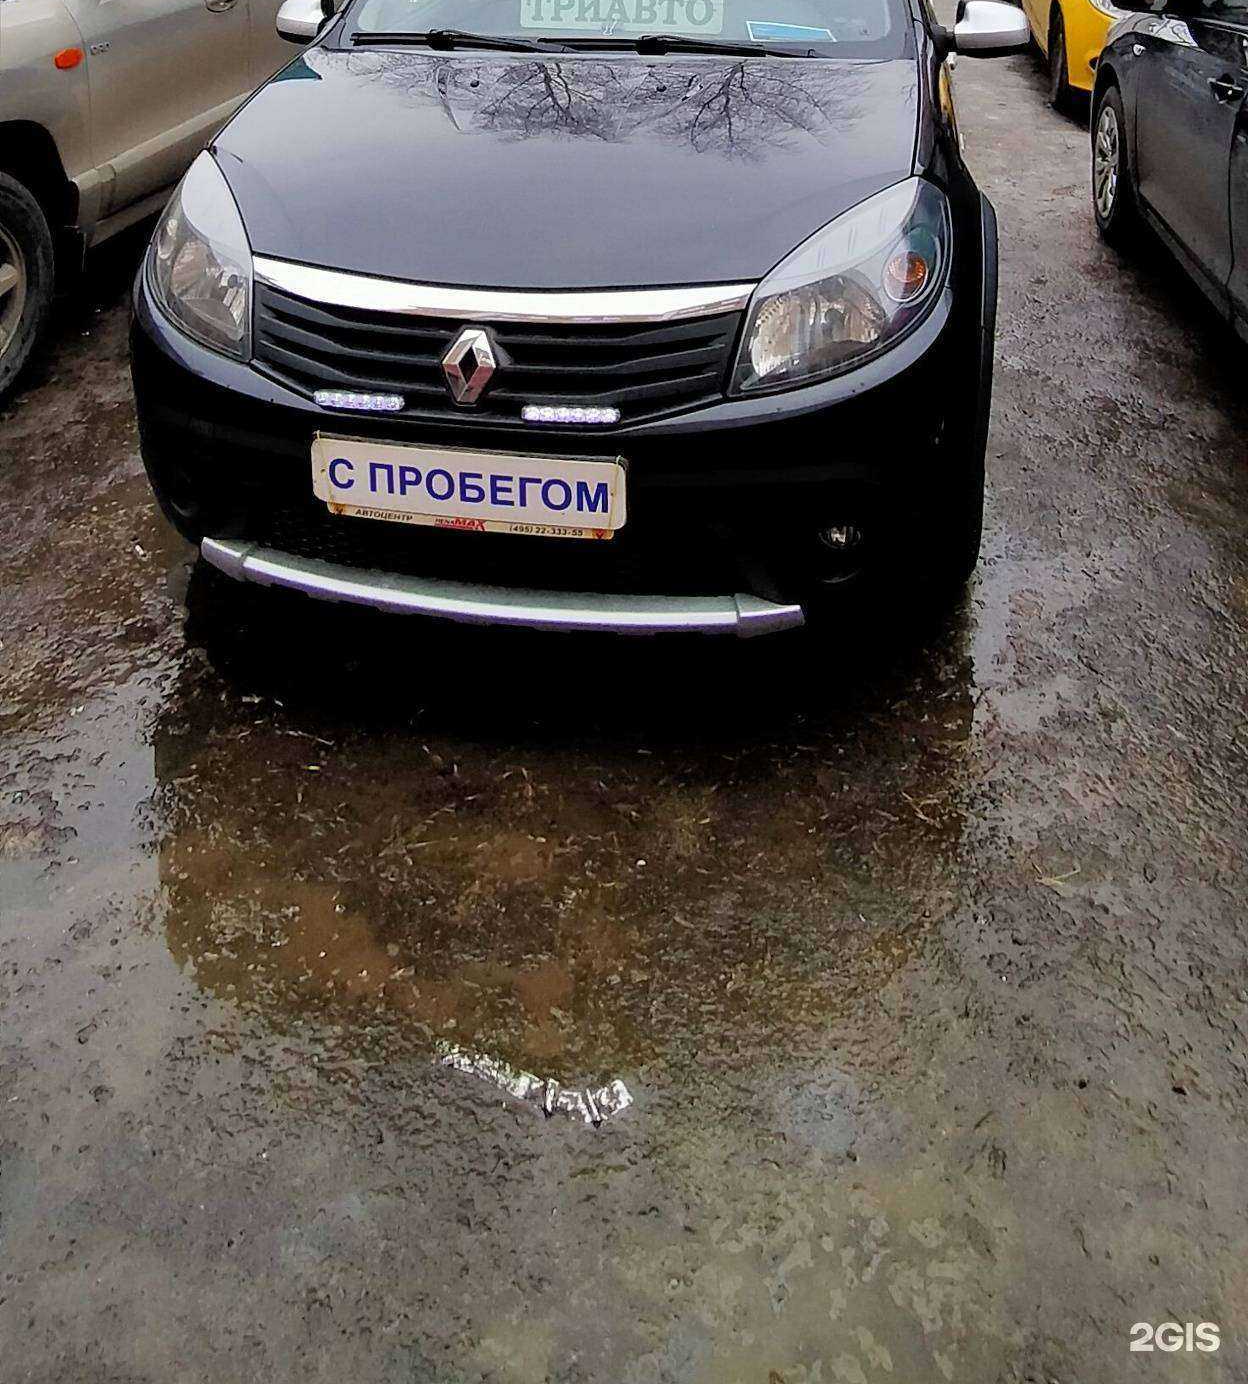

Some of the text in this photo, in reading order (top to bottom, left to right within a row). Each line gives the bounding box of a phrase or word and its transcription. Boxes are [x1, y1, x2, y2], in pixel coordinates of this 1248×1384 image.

[328, 458, 609, 513] С ПРОБЕГОМ
[355, 508, 413, 522] АВТОЦЕНТР
